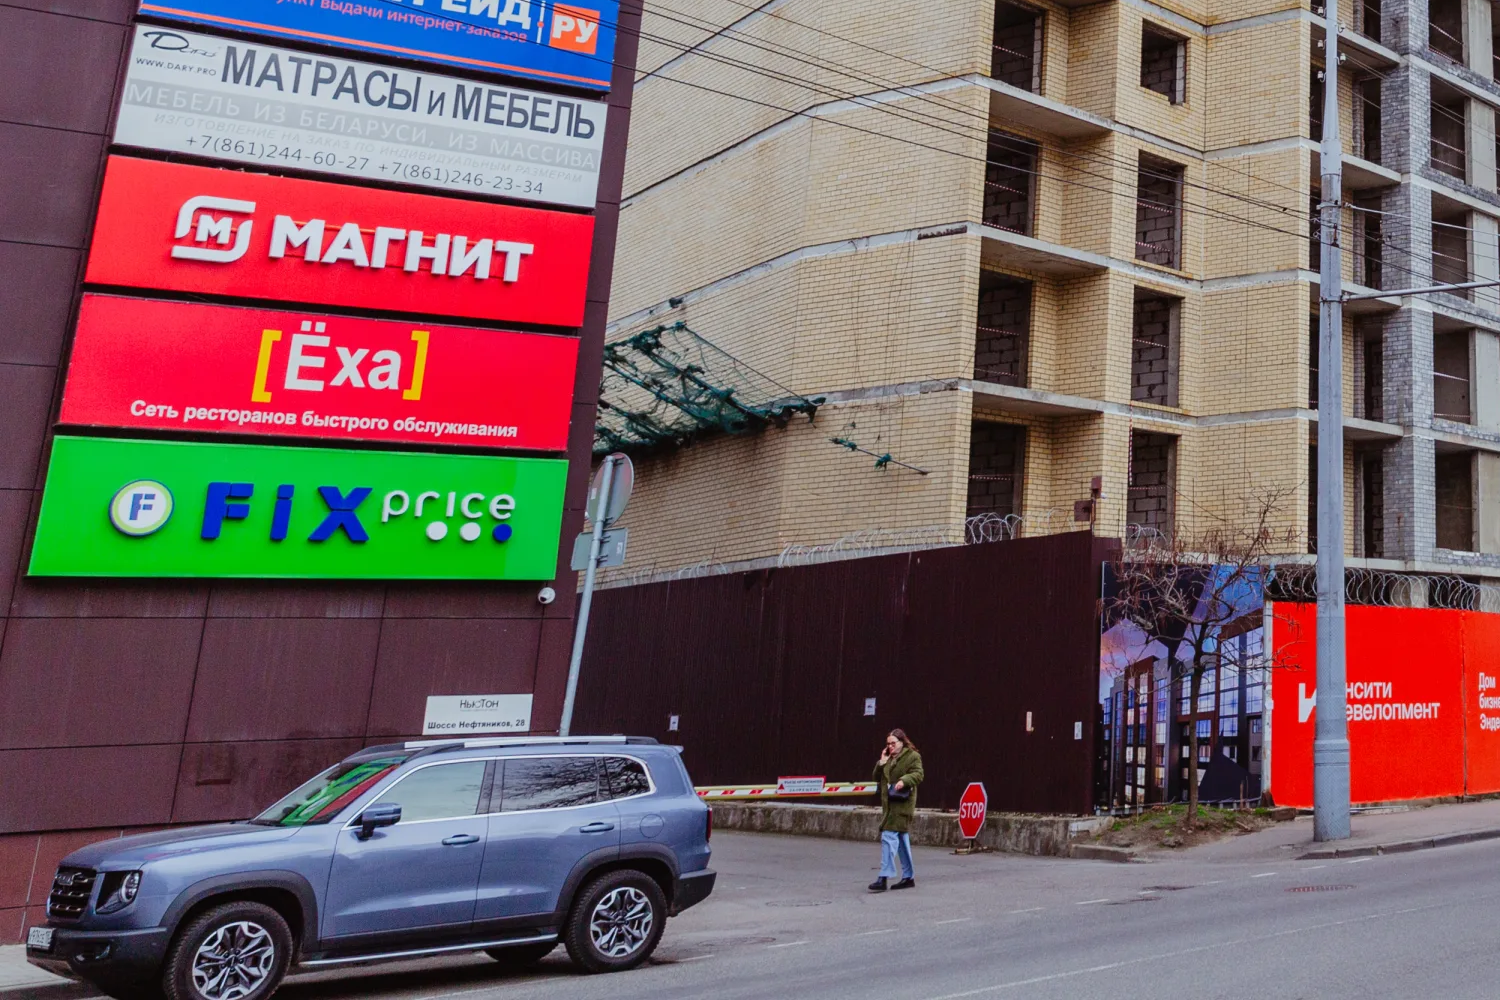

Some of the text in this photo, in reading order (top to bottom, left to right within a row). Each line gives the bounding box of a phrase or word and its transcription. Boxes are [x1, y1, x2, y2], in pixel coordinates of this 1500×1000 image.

[387, 11, 528, 44] интернет-заказов
[136, 57, 217, 77] WWW.DARY.PRO
[222, 45, 421, 113] МАТРАСЫ
[453, 84, 596, 140] МЕБЕЛЬ
[128, 83, 596, 170] МЕБЕЛЬ ИЗ БЕЛАРУСИ, ИЗ МАССИВА
[153, 113, 584, 184] ИЗГОТОВЛЕНИЕ НА ЗАКАЗ ПО ИНДИВИДУАЛЬНЫМ РАЗМЕРАМ
[186, 134, 544, 195] +7(861)244-60-27 +7(861)246-23-34
[268, 214, 535, 284] МАГНИТ
[130, 399, 519, 439] Сеть ресторанов быстрого обслуживания
[381, 489, 517, 524] price
[1346, 682, 1392, 699] нсити
[1478, 671, 1496, 691] Дом
[428, 719, 525, 731] Шоссе Нефтяников, 28
[1346, 701, 1440, 722] евелопмент
[961, 801, 985, 820] STOP
